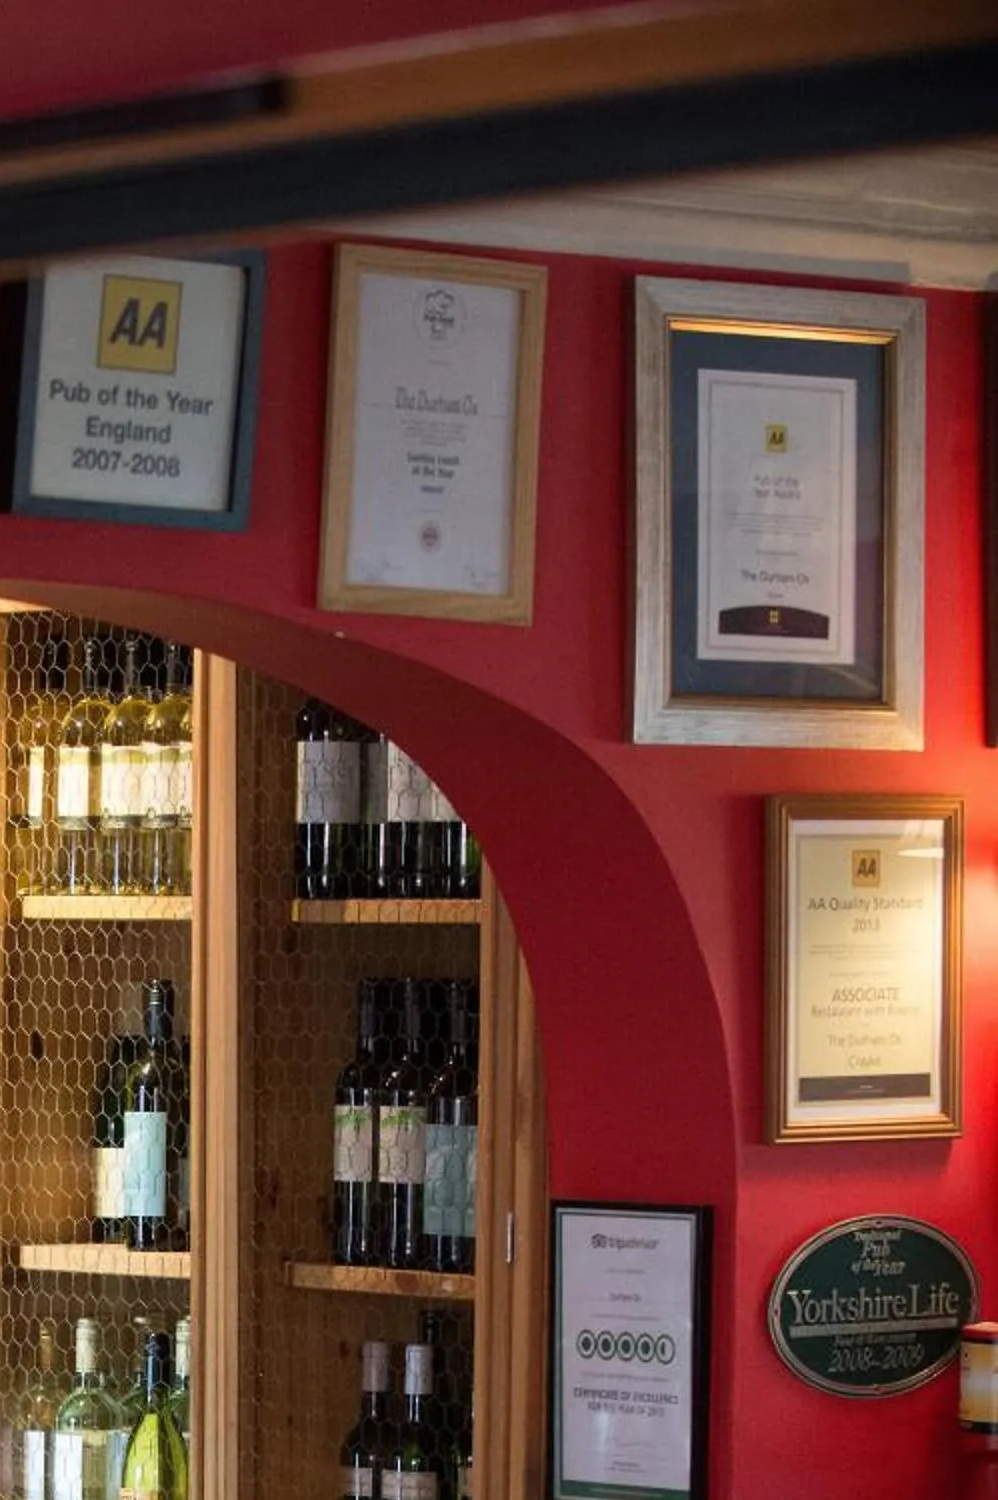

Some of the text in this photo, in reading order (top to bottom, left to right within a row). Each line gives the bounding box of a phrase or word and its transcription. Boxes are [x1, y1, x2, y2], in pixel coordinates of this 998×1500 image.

[109, 297, 168, 349] AA
[49, 378, 214, 416] Pub of the Year
[85, 416, 172, 445] England
[71, 448, 181, 478] 2007-2008
[857, 857, 877, 878] AA
[807, 897, 827, 911] AA
[829, 896, 871, 914] Quality
[832, 987, 901, 1002] ASSOCIATE
[860, 1238, 891, 1262] Pub
[787, 1281, 960, 1324] Yorkshire Life
